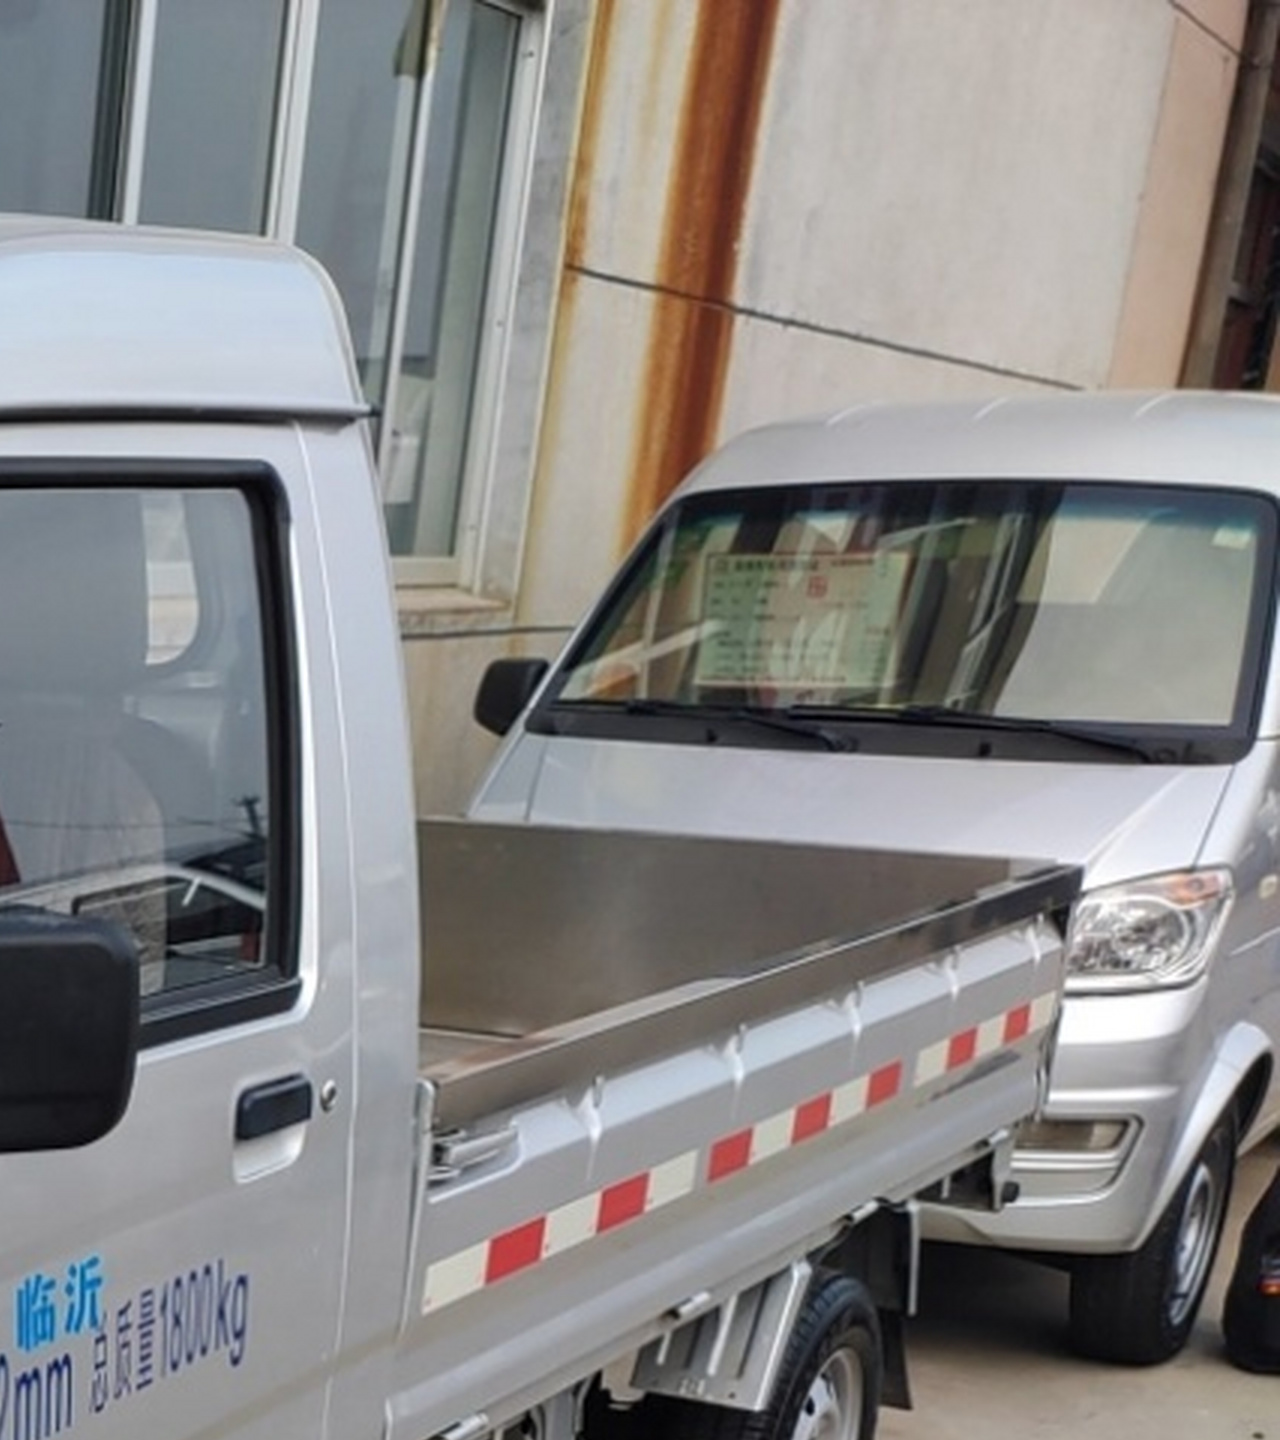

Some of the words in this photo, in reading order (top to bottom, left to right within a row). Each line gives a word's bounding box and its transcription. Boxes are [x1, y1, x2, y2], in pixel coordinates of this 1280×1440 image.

[16, 1256, 104, 1351] 临沂
[88, 1258, 249, 1413] 总质量1800kg
